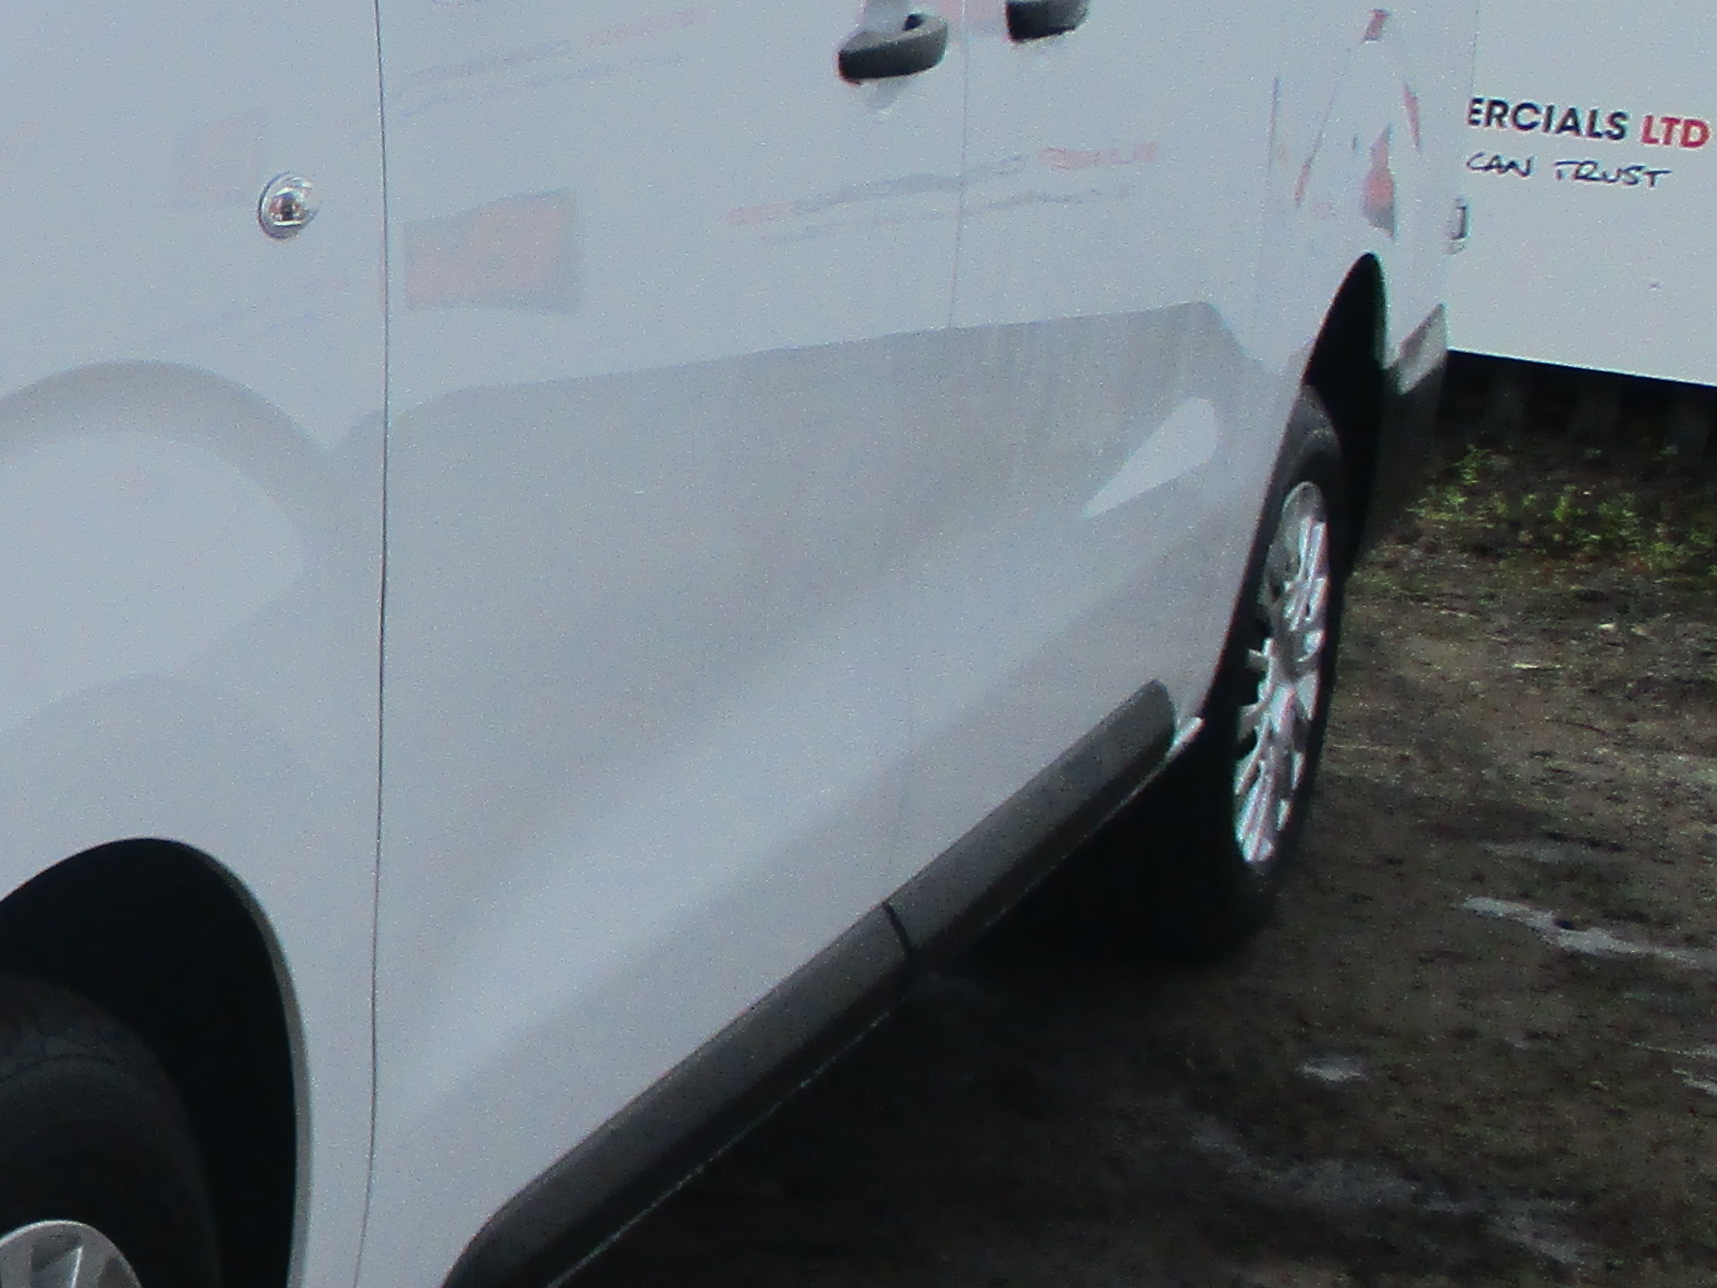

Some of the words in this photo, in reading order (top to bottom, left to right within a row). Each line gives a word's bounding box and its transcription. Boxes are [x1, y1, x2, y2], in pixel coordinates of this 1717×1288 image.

[1640, 115, 1711, 149] LTD
[1466, 152, 1534, 178] CAN
[1551, 160, 1673, 187] TRUST
